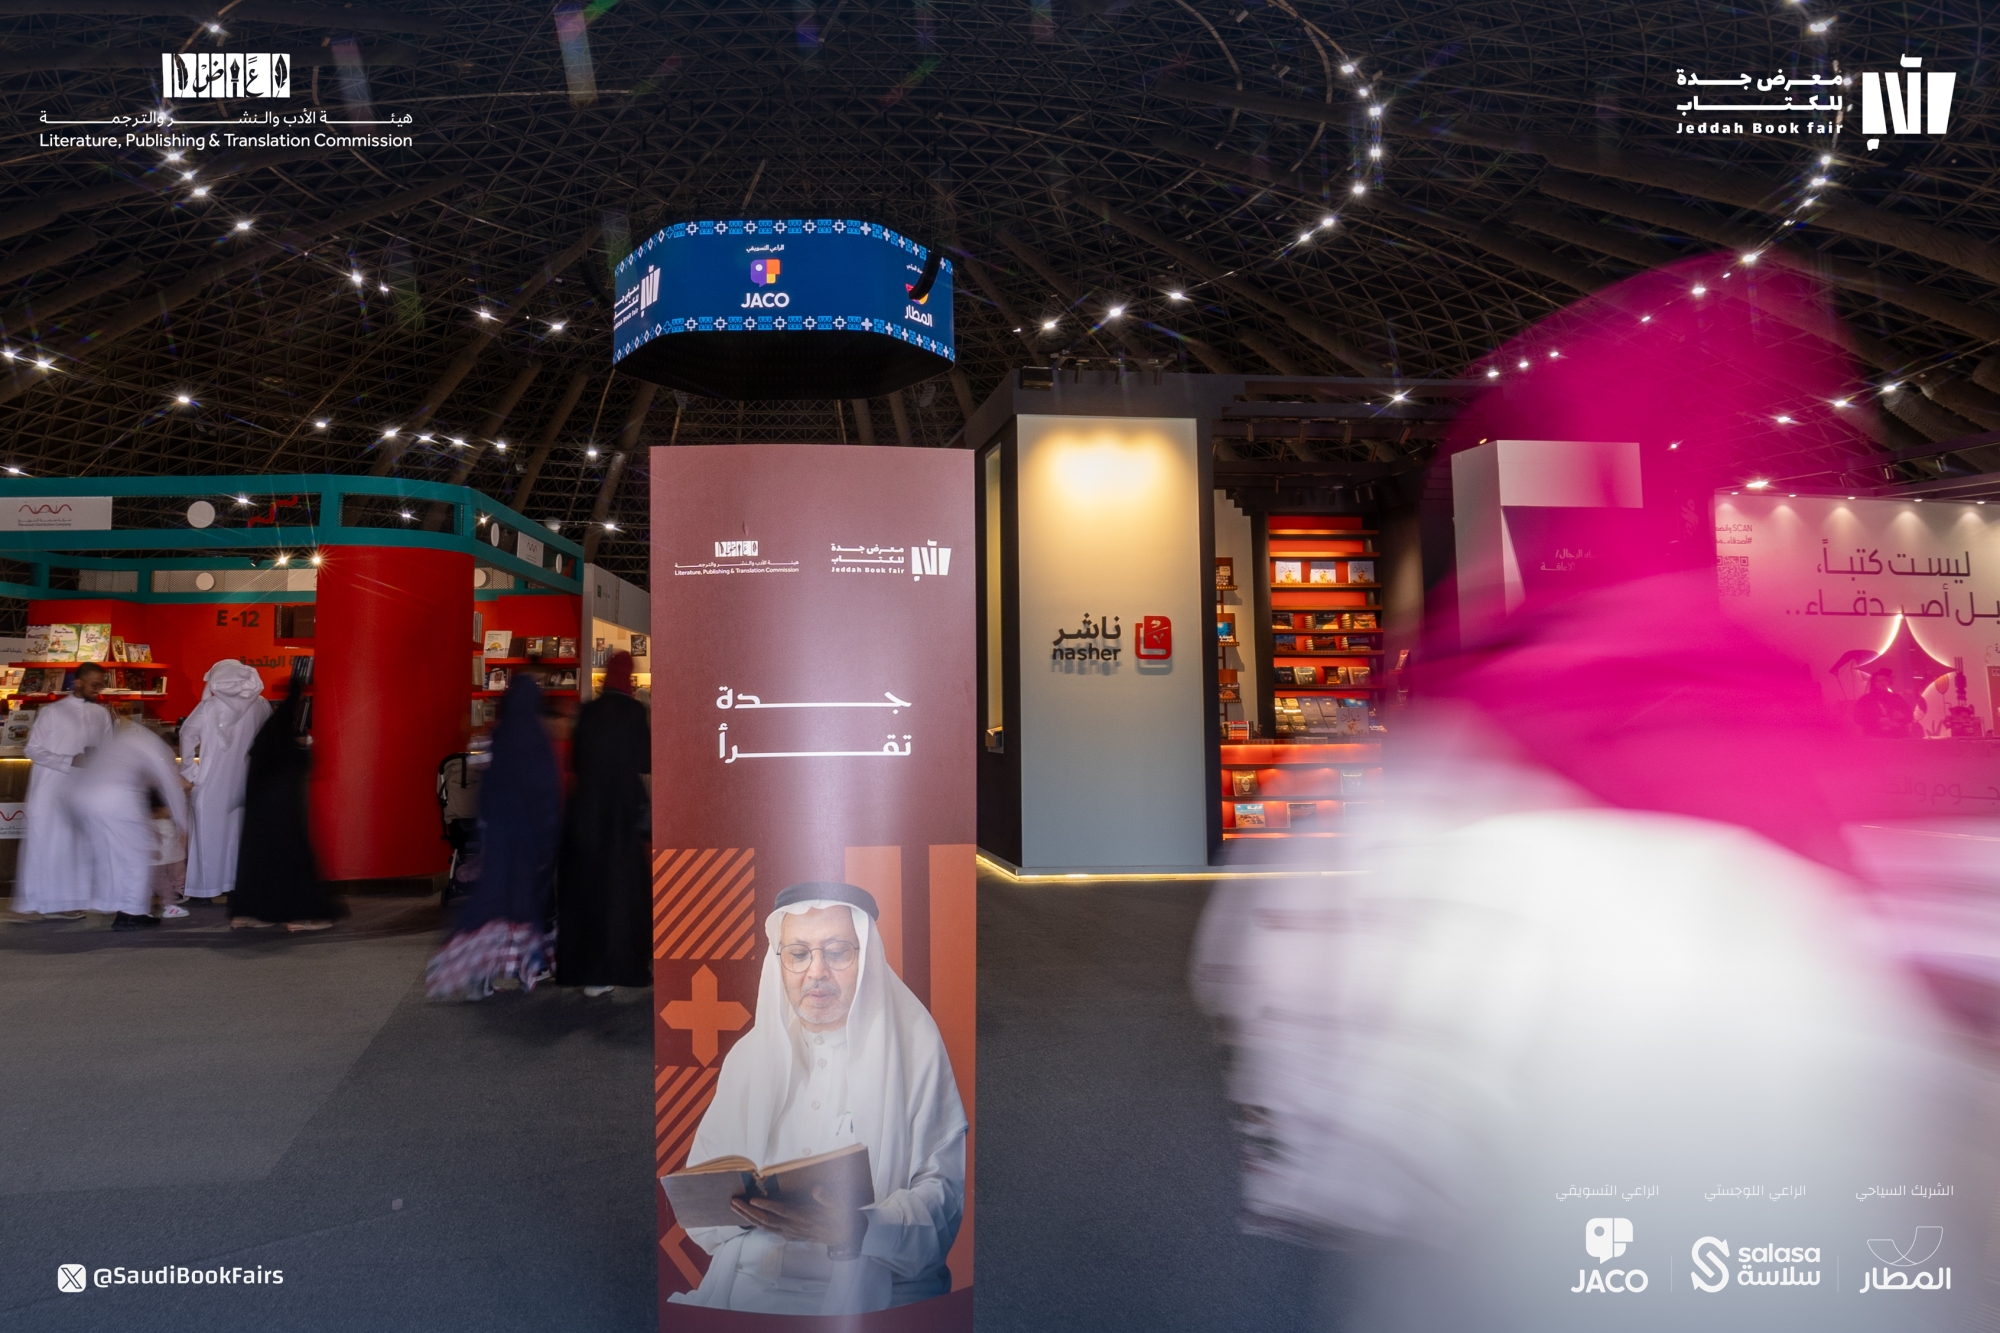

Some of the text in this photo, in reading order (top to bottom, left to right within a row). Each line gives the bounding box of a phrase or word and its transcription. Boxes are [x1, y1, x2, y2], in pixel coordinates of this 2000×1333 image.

[741, 293, 789, 308] JACO
[905, 304, 933, 327] المطار
[1732, 523, 1753, 533] SCAN
[830, 543, 905, 555] معرض جدة
[830, 554, 905, 565] للكتاب
[1887, 551, 1971, 584] ليست
[674, 568, 702, 576] Literature,
[703, 568, 730, 576] Publishing
[831, 566, 905, 575] Jeddah Book fair
[1956, 592, 2000, 626] بل
[1052, 612, 1122, 644] ناشر
[1052, 644, 1122, 661] nasher
[717, 687, 911, 714] جدة
[719, 724, 911, 763] تقرأ
